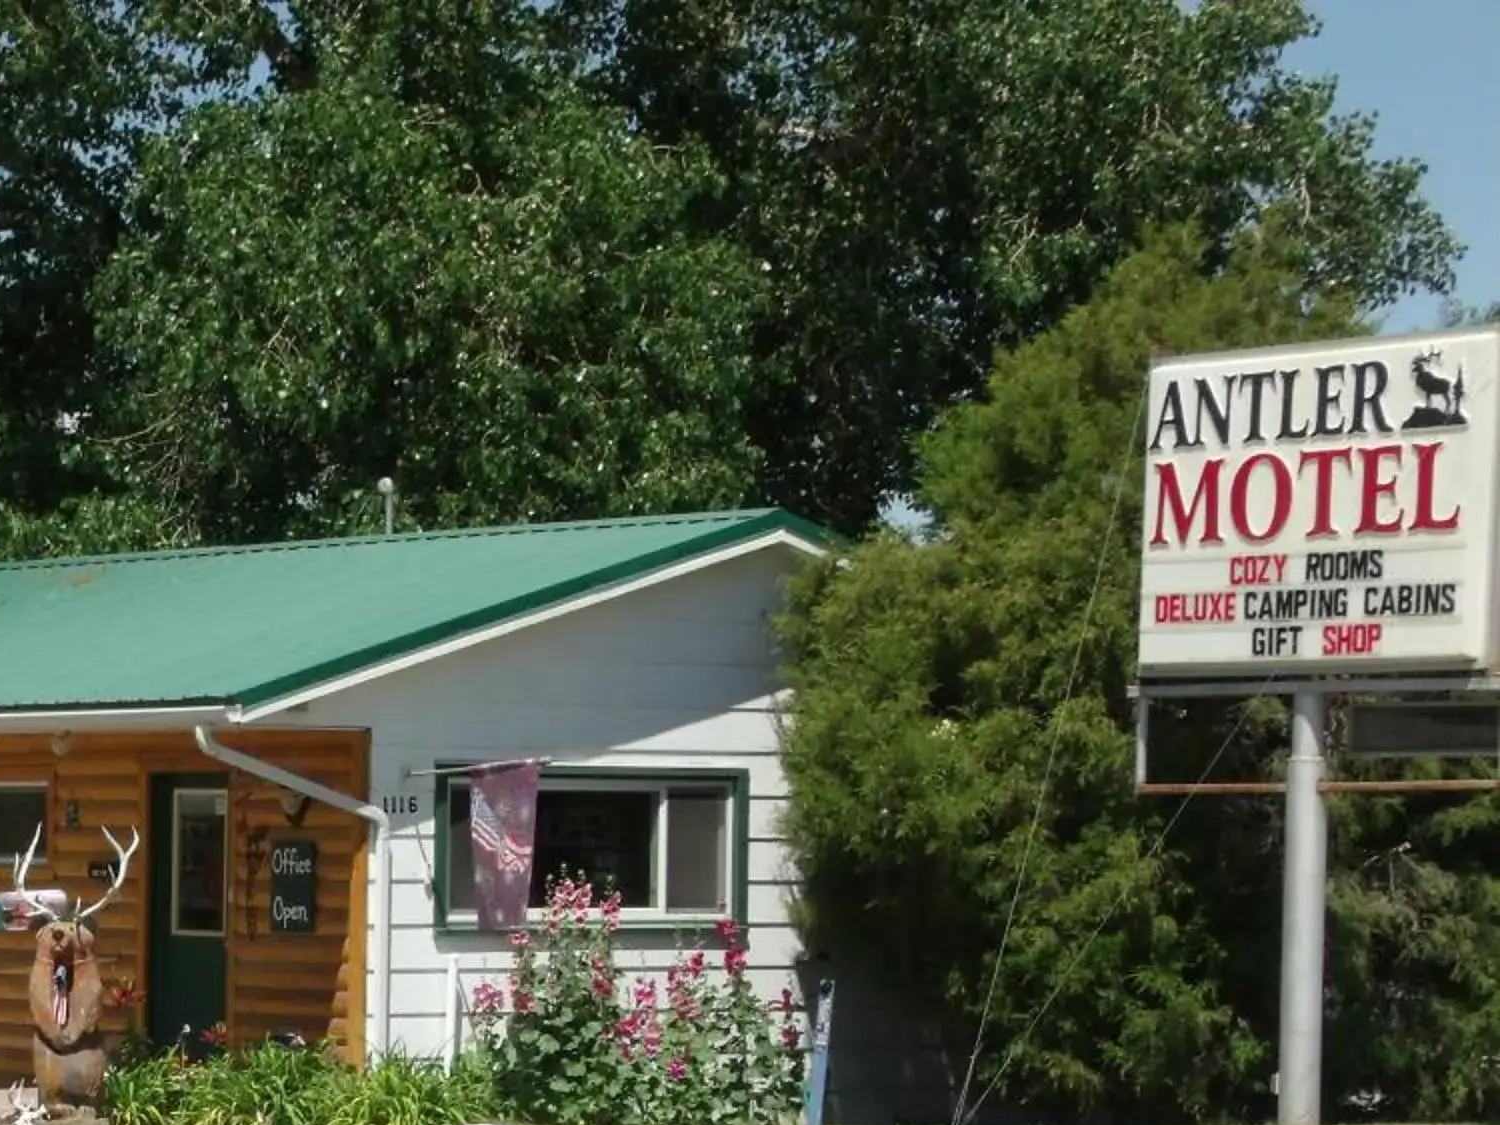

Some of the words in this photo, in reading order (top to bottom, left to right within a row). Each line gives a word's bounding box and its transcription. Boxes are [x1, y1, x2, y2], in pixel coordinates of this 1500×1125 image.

[1150, 361, 1393, 450] ANTLER
[1150, 442, 1461, 547] MOTEL
[1230, 555, 1288, 584] COZY
[1305, 551, 1383, 580] ROOMS
[1155, 593, 1237, 622] DELUXE
[1244, 588, 1349, 619] CAMPING
[1363, 584, 1456, 615] CABINS
[1252, 627, 1302, 655] GIFT
[1322, 624, 1383, 655] SHOP
[383, 796, 418, 814] 1116
[272, 848, 312, 874] Office
[273, 896, 309, 928] Open
